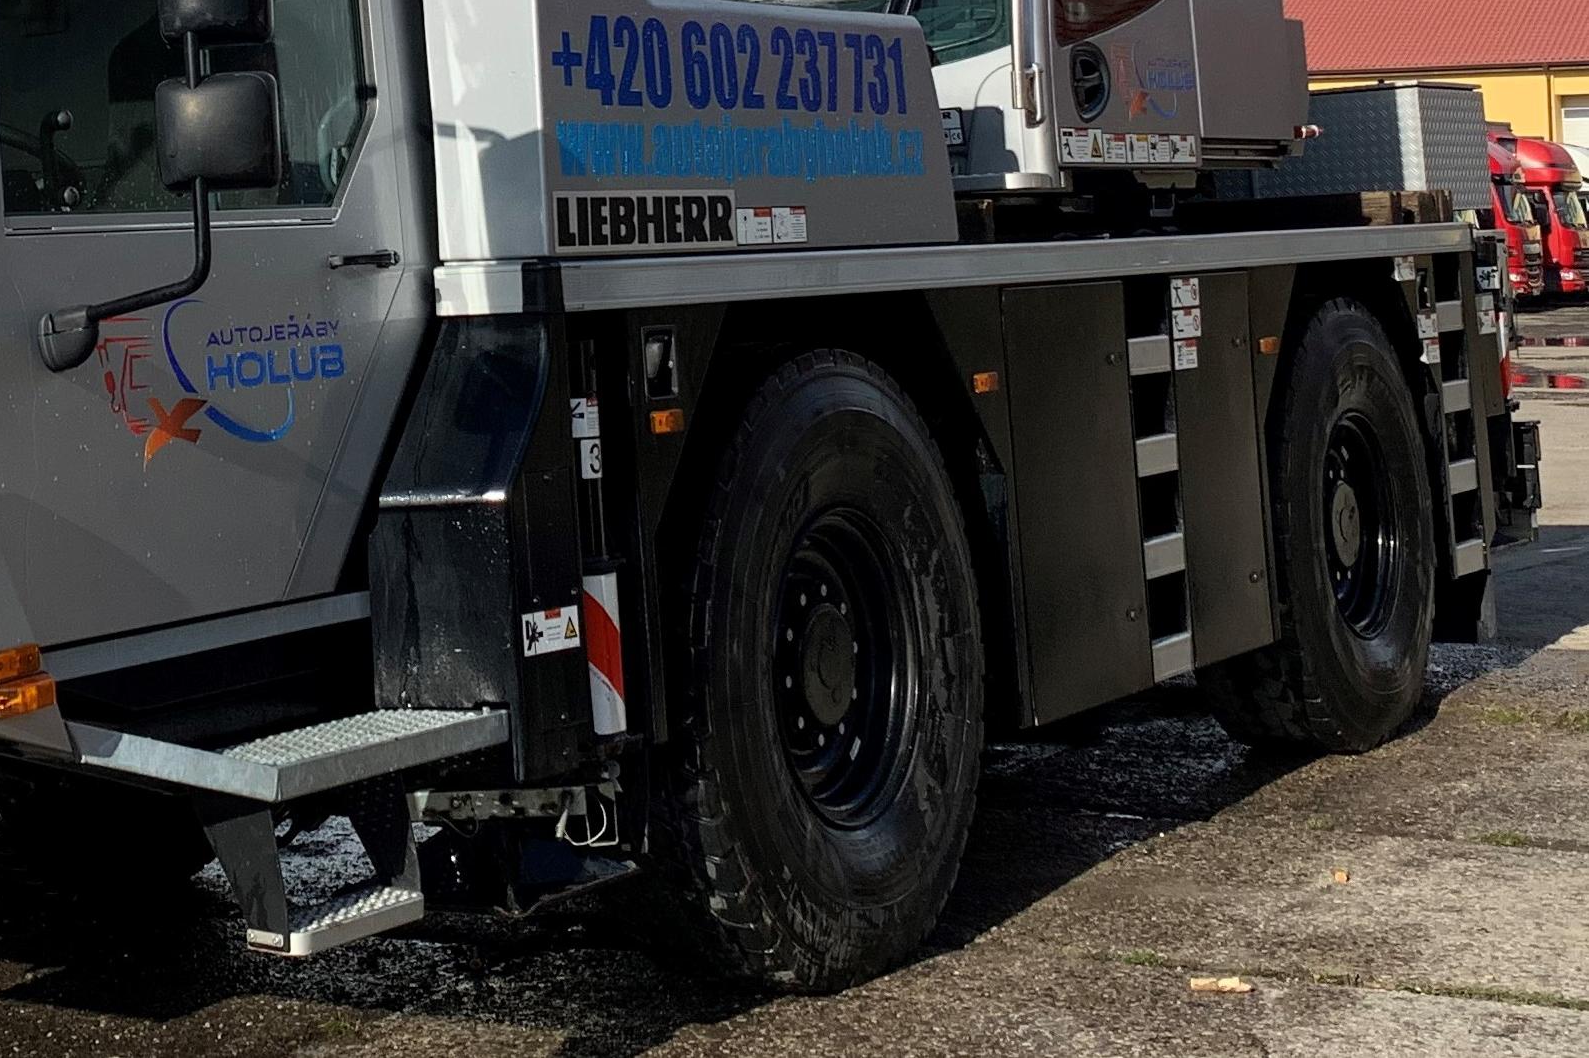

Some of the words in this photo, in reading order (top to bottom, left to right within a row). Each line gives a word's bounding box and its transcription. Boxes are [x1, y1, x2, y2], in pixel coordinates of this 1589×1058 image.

[552, 15, 672, 110] +420
[681, 20, 765, 110] 602
[770, 26, 838, 113] 237
[844, 33, 907, 115] 731
[556, 194, 734, 247] LIEBHERR
[206, 343, 347, 390] HOLUB
[589, 443, 602, 475] 3
